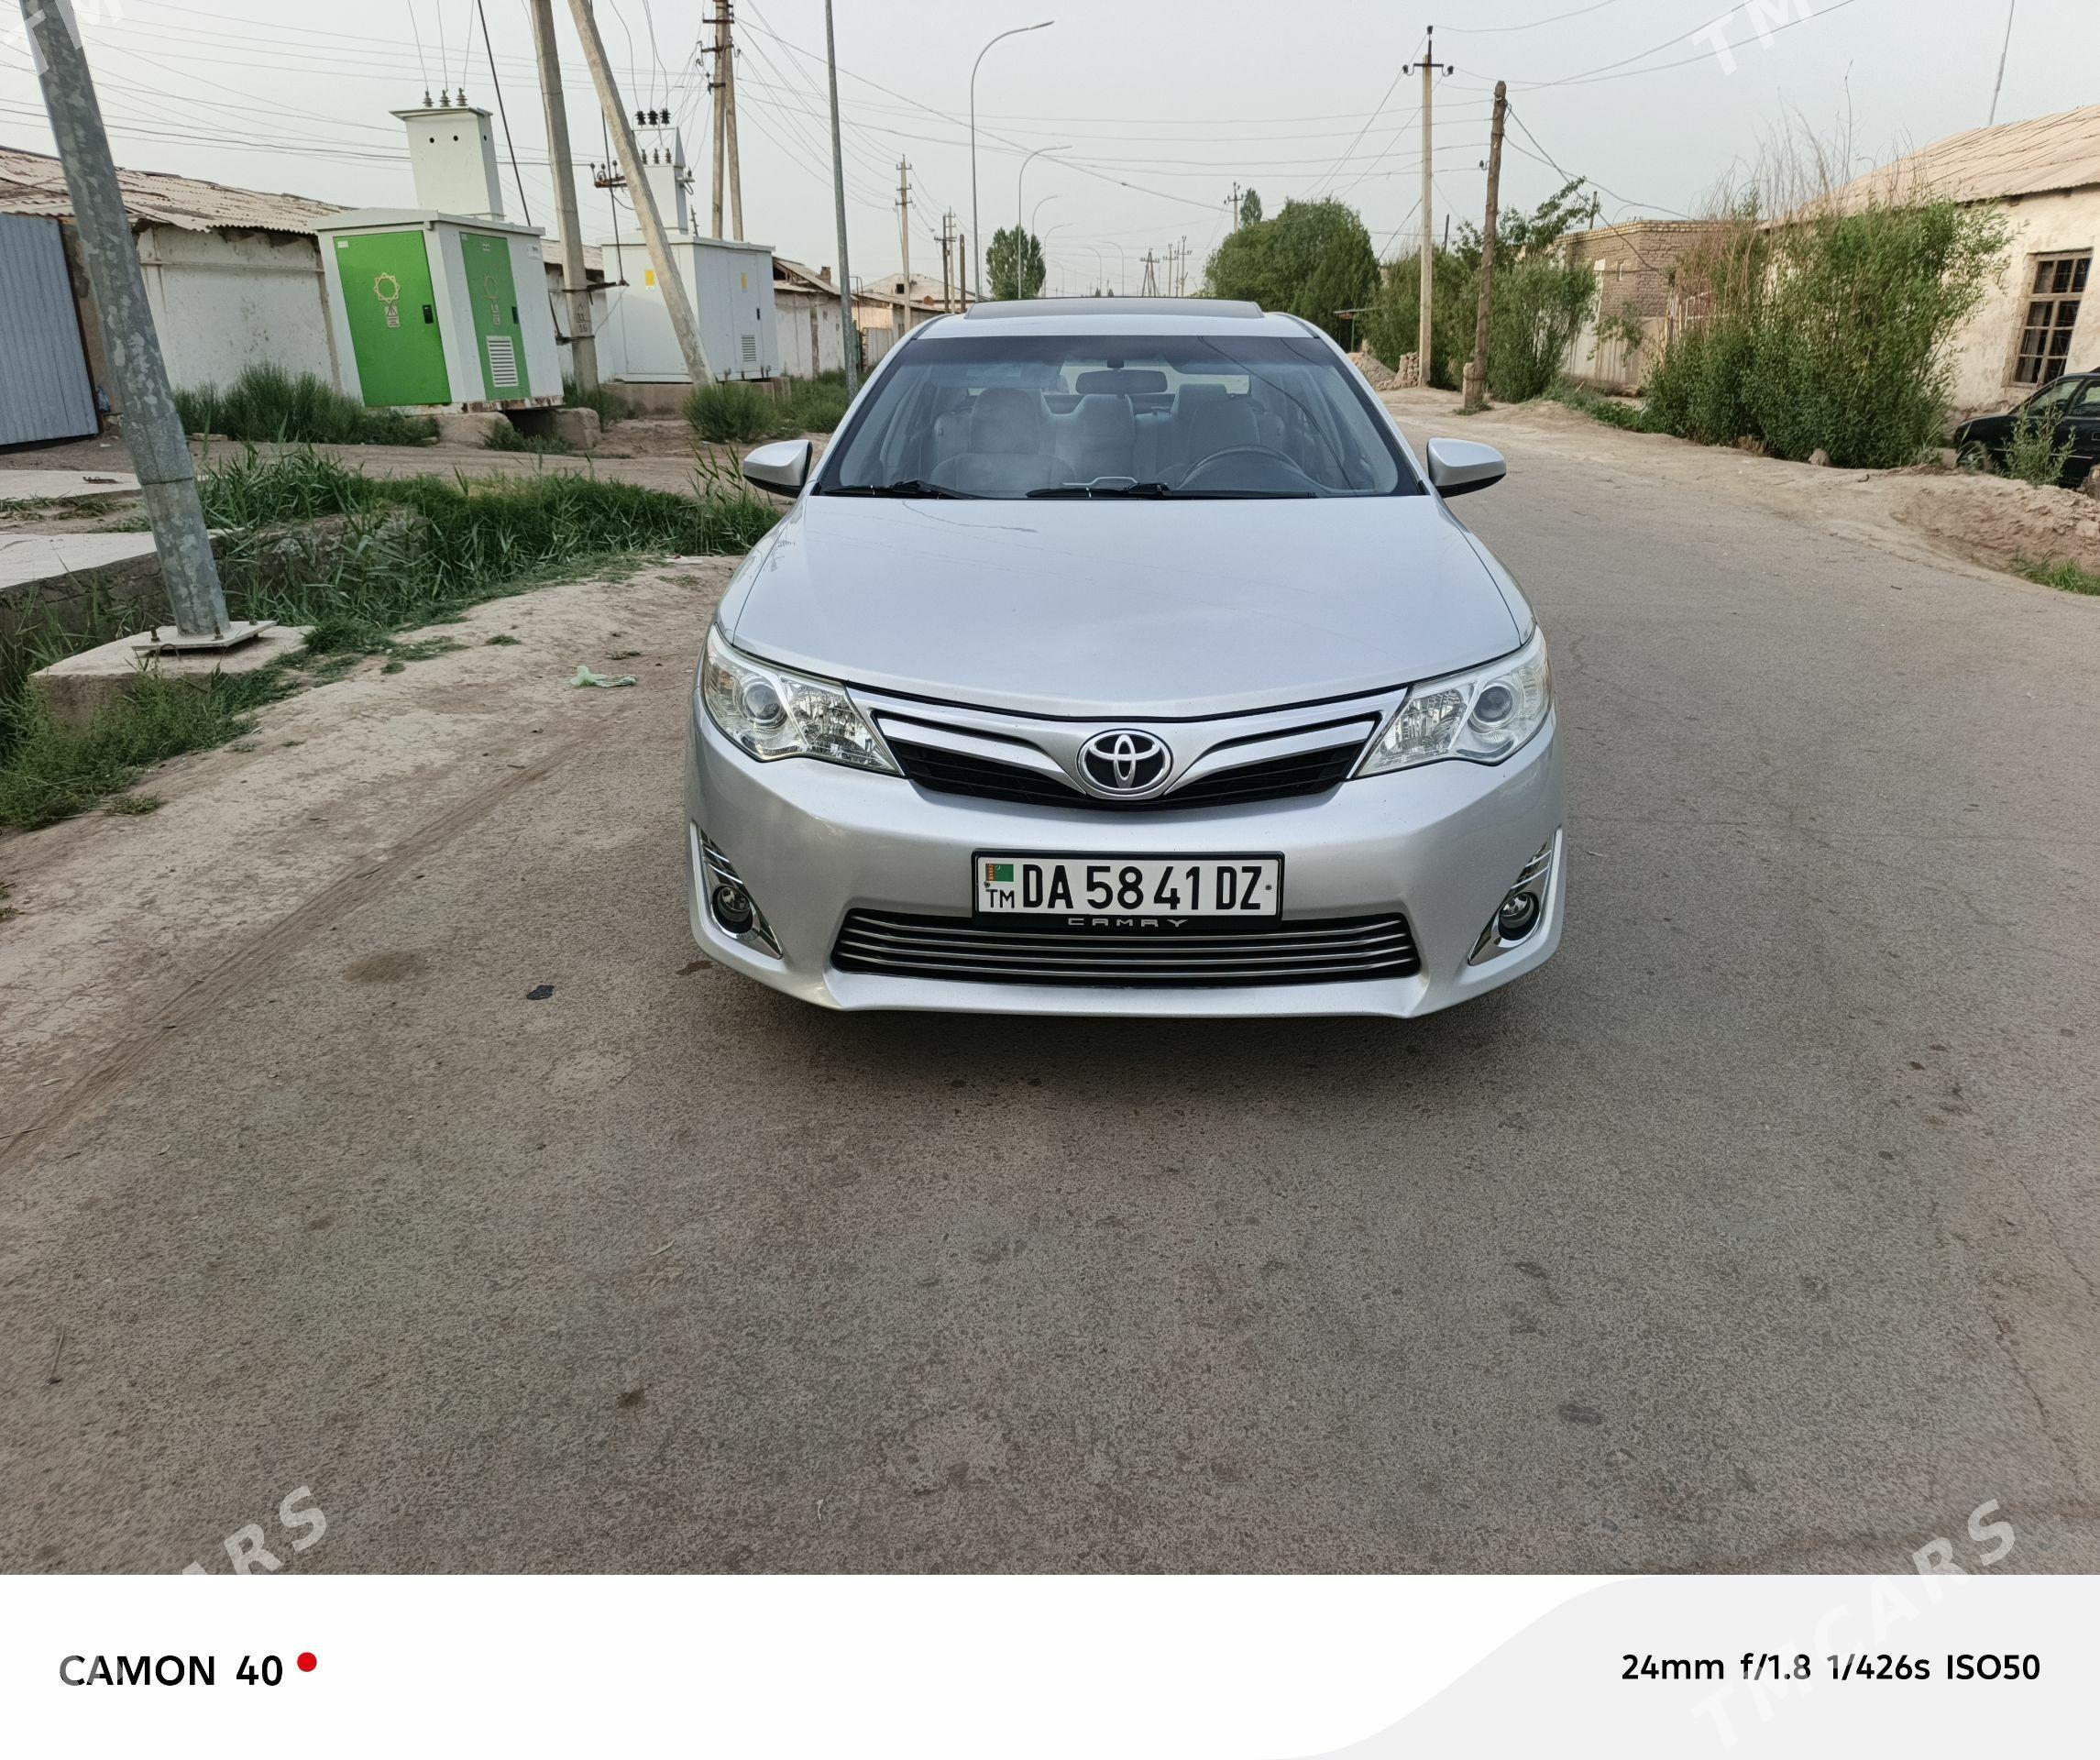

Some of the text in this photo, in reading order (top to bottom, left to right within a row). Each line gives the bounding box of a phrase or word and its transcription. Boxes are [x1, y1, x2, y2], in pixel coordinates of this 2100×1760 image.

[1022, 864, 1262, 910] DA 5841 DZ
[985, 888, 1016, 909] TM
[1068, 918, 1189, 928] CAMRY
